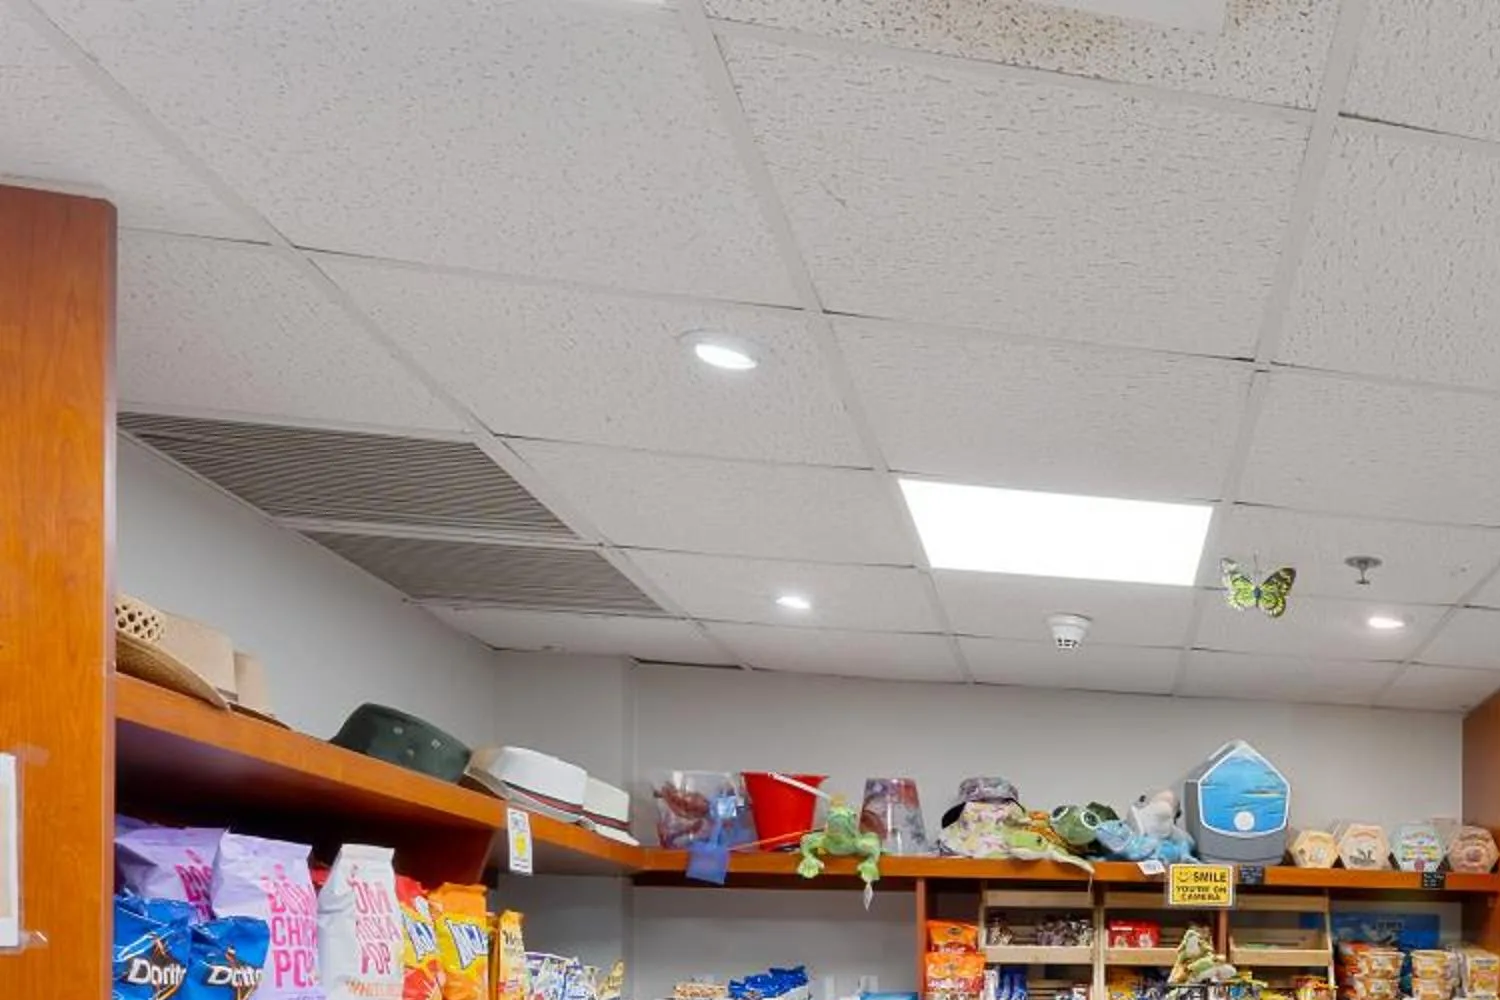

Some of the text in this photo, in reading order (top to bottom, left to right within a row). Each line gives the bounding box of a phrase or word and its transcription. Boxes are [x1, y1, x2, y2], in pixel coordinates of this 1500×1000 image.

[1193, 871, 1226, 883] SMILE
[1214, 886, 1227, 894] ON
[1181, 893, 1221, 901] CAMERA
